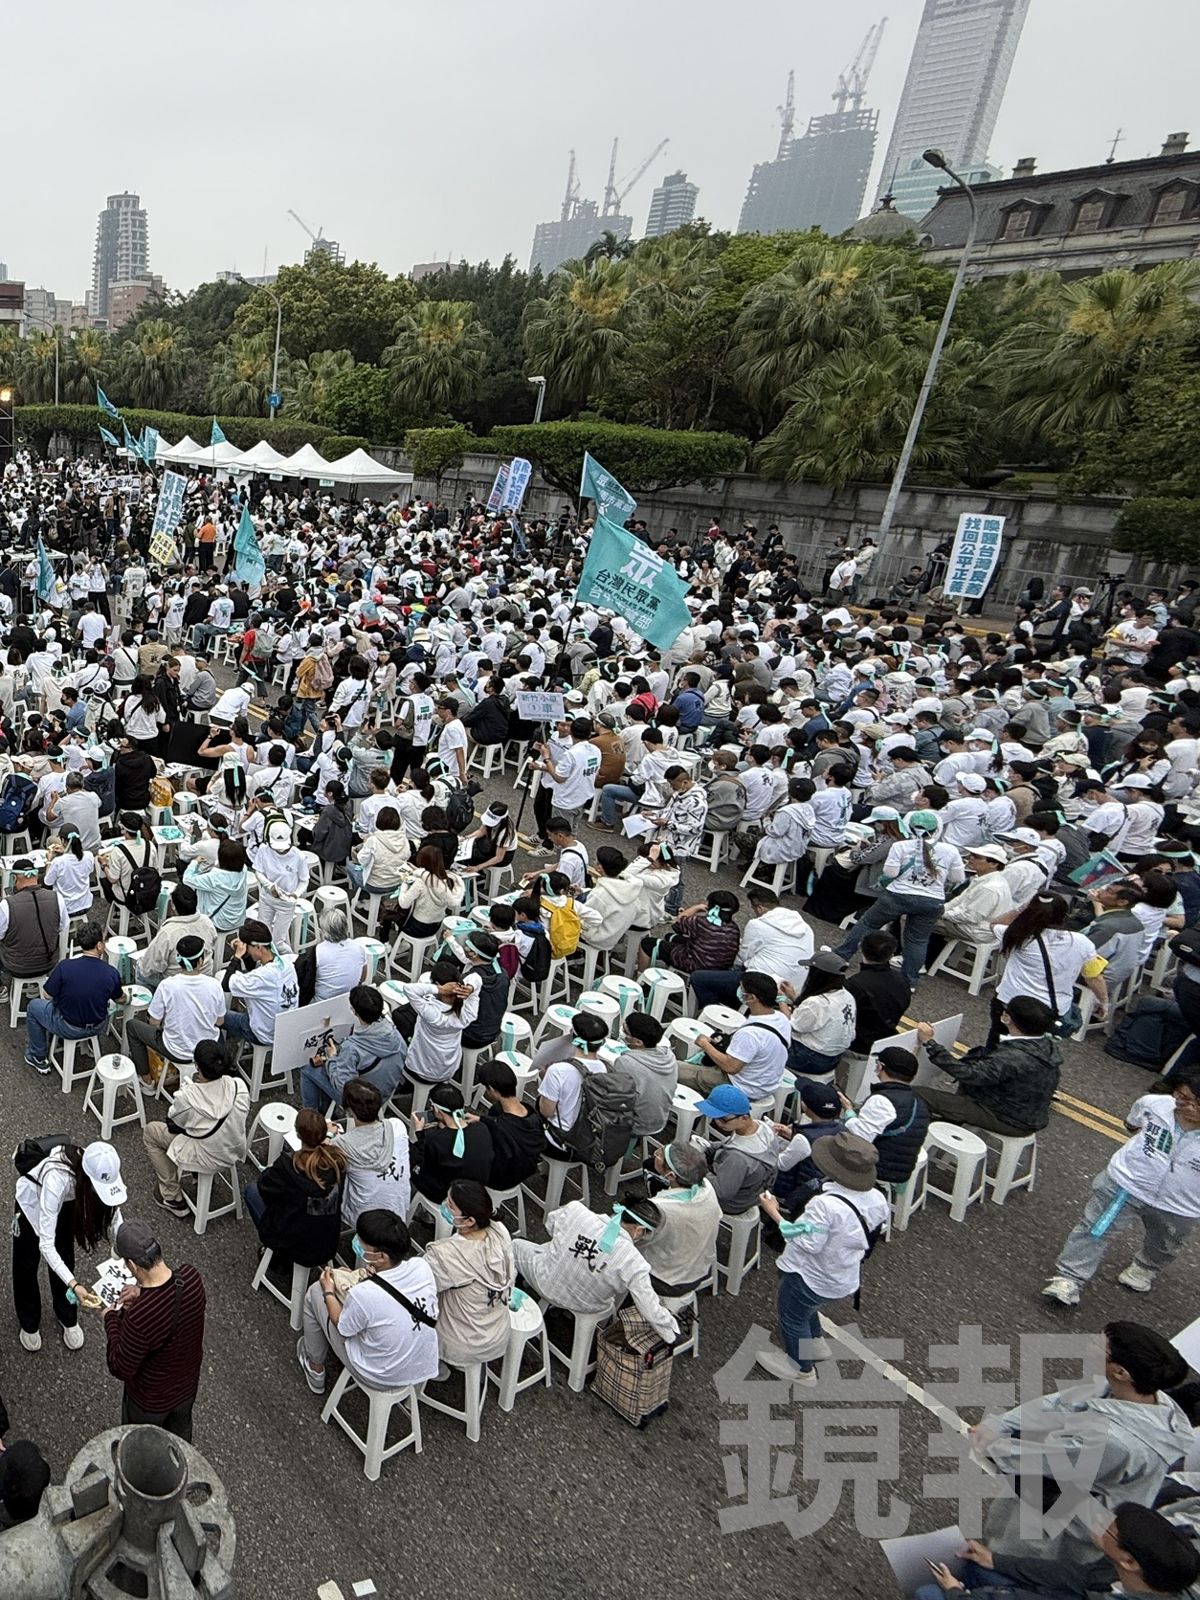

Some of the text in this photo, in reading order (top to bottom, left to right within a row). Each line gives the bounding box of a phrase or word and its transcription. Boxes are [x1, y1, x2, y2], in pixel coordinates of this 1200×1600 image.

[949, 517, 981, 592] 找回公平正義
[596, 569, 662, 612] 台灣民眾黨
[569, 1234, 607, 1272] 戰!
